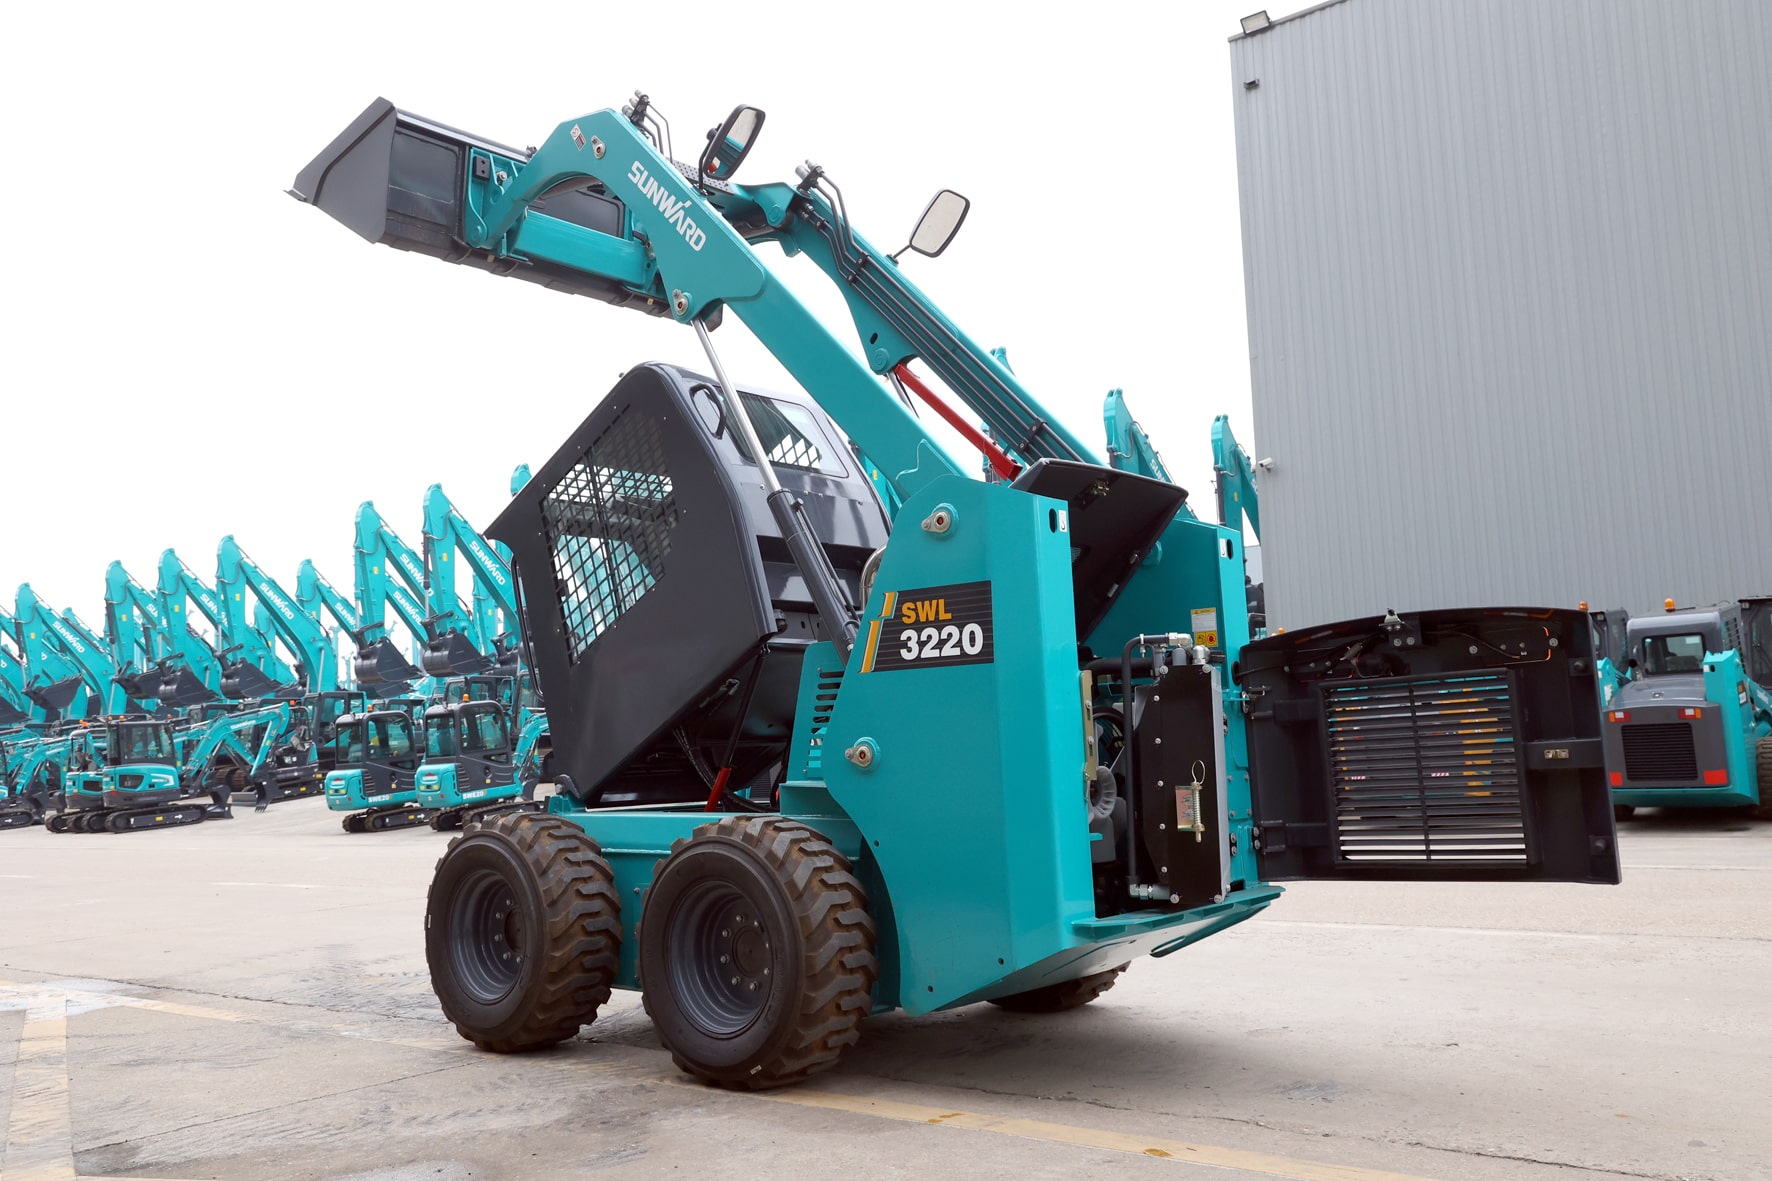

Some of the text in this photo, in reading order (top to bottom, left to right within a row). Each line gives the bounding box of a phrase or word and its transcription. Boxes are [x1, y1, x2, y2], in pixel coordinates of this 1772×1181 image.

[627, 160, 706, 252] SUNWARD
[400, 553, 434, 597] SUNWD
[470, 541, 506, 585] SUNWARD
[259, 582, 295, 620] SUNWARD
[393, 591, 422, 626] SUNWAR
[901, 598, 953, 625] SWL
[899, 622, 984, 661] 3220
